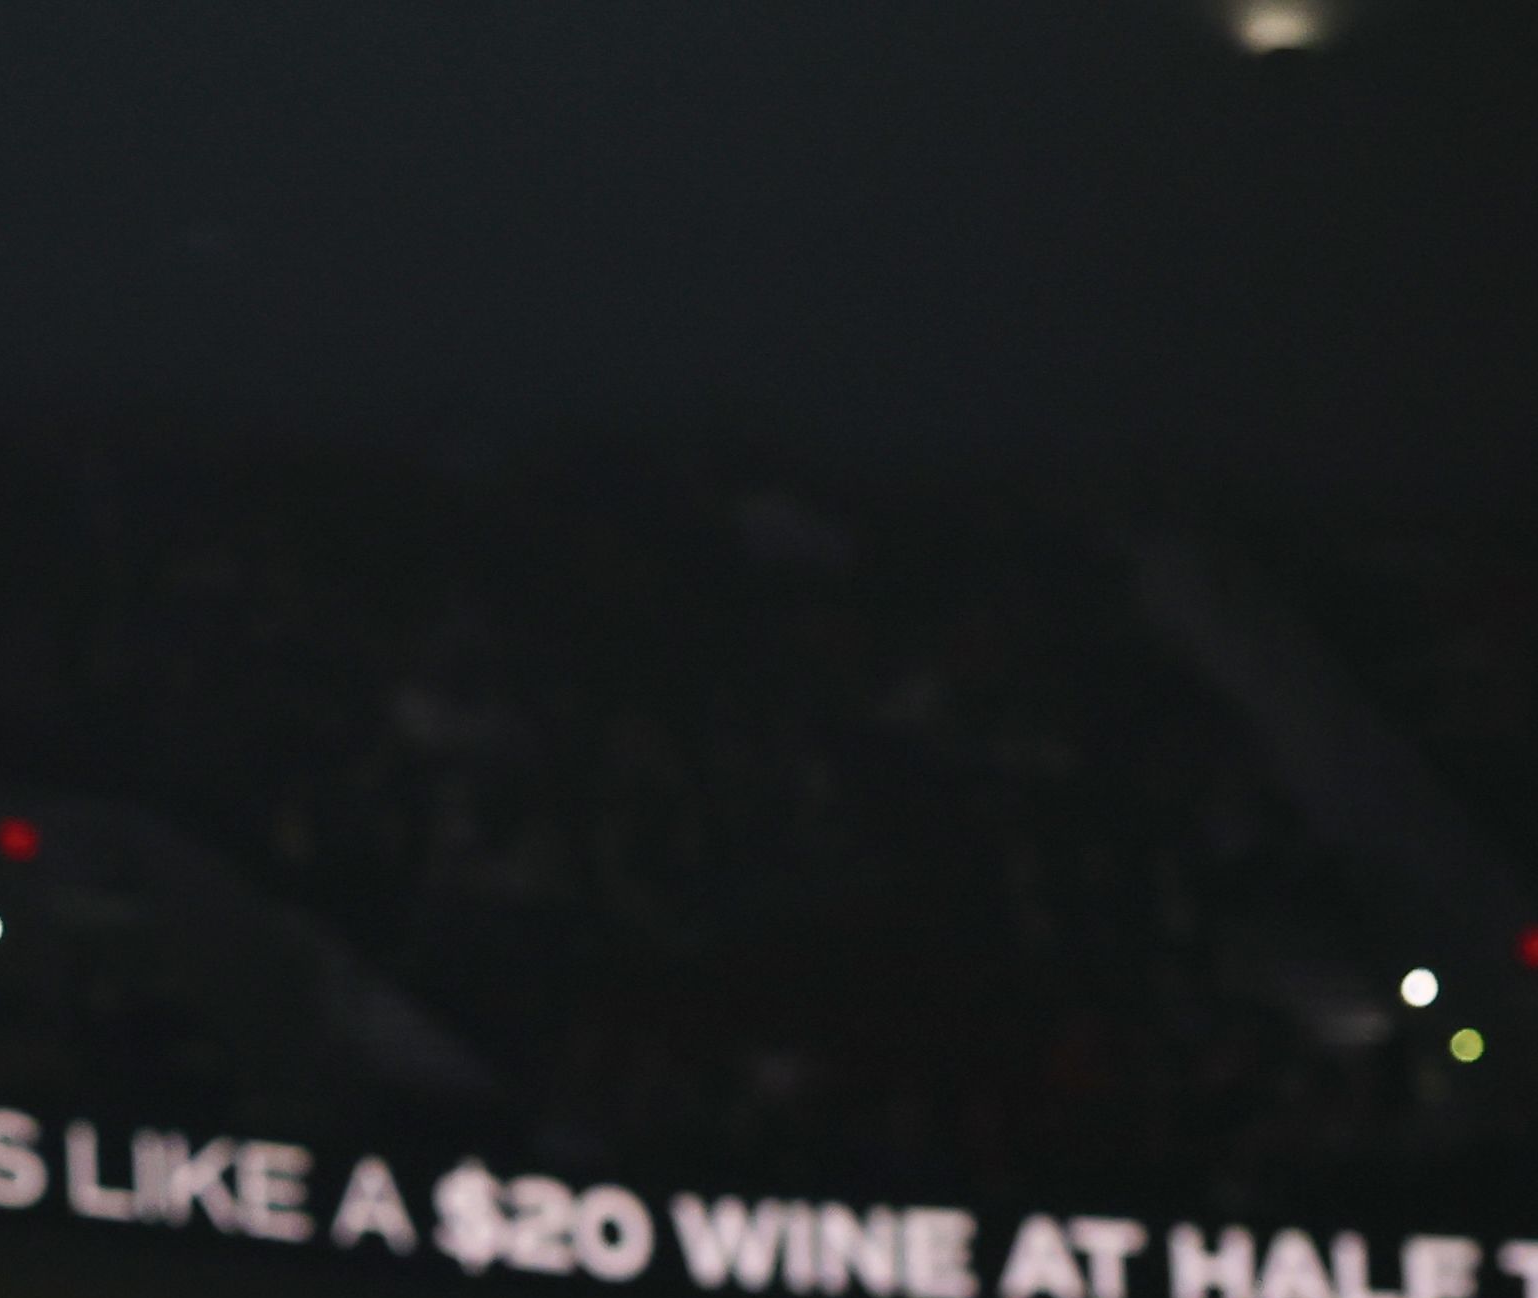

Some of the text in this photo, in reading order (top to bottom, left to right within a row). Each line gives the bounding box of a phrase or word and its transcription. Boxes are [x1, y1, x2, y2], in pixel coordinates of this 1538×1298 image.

[65, 1122, 313, 1242] LIKE
[331, 1156, 416, 1254] A
[432, 1158, 653, 1282] $20
